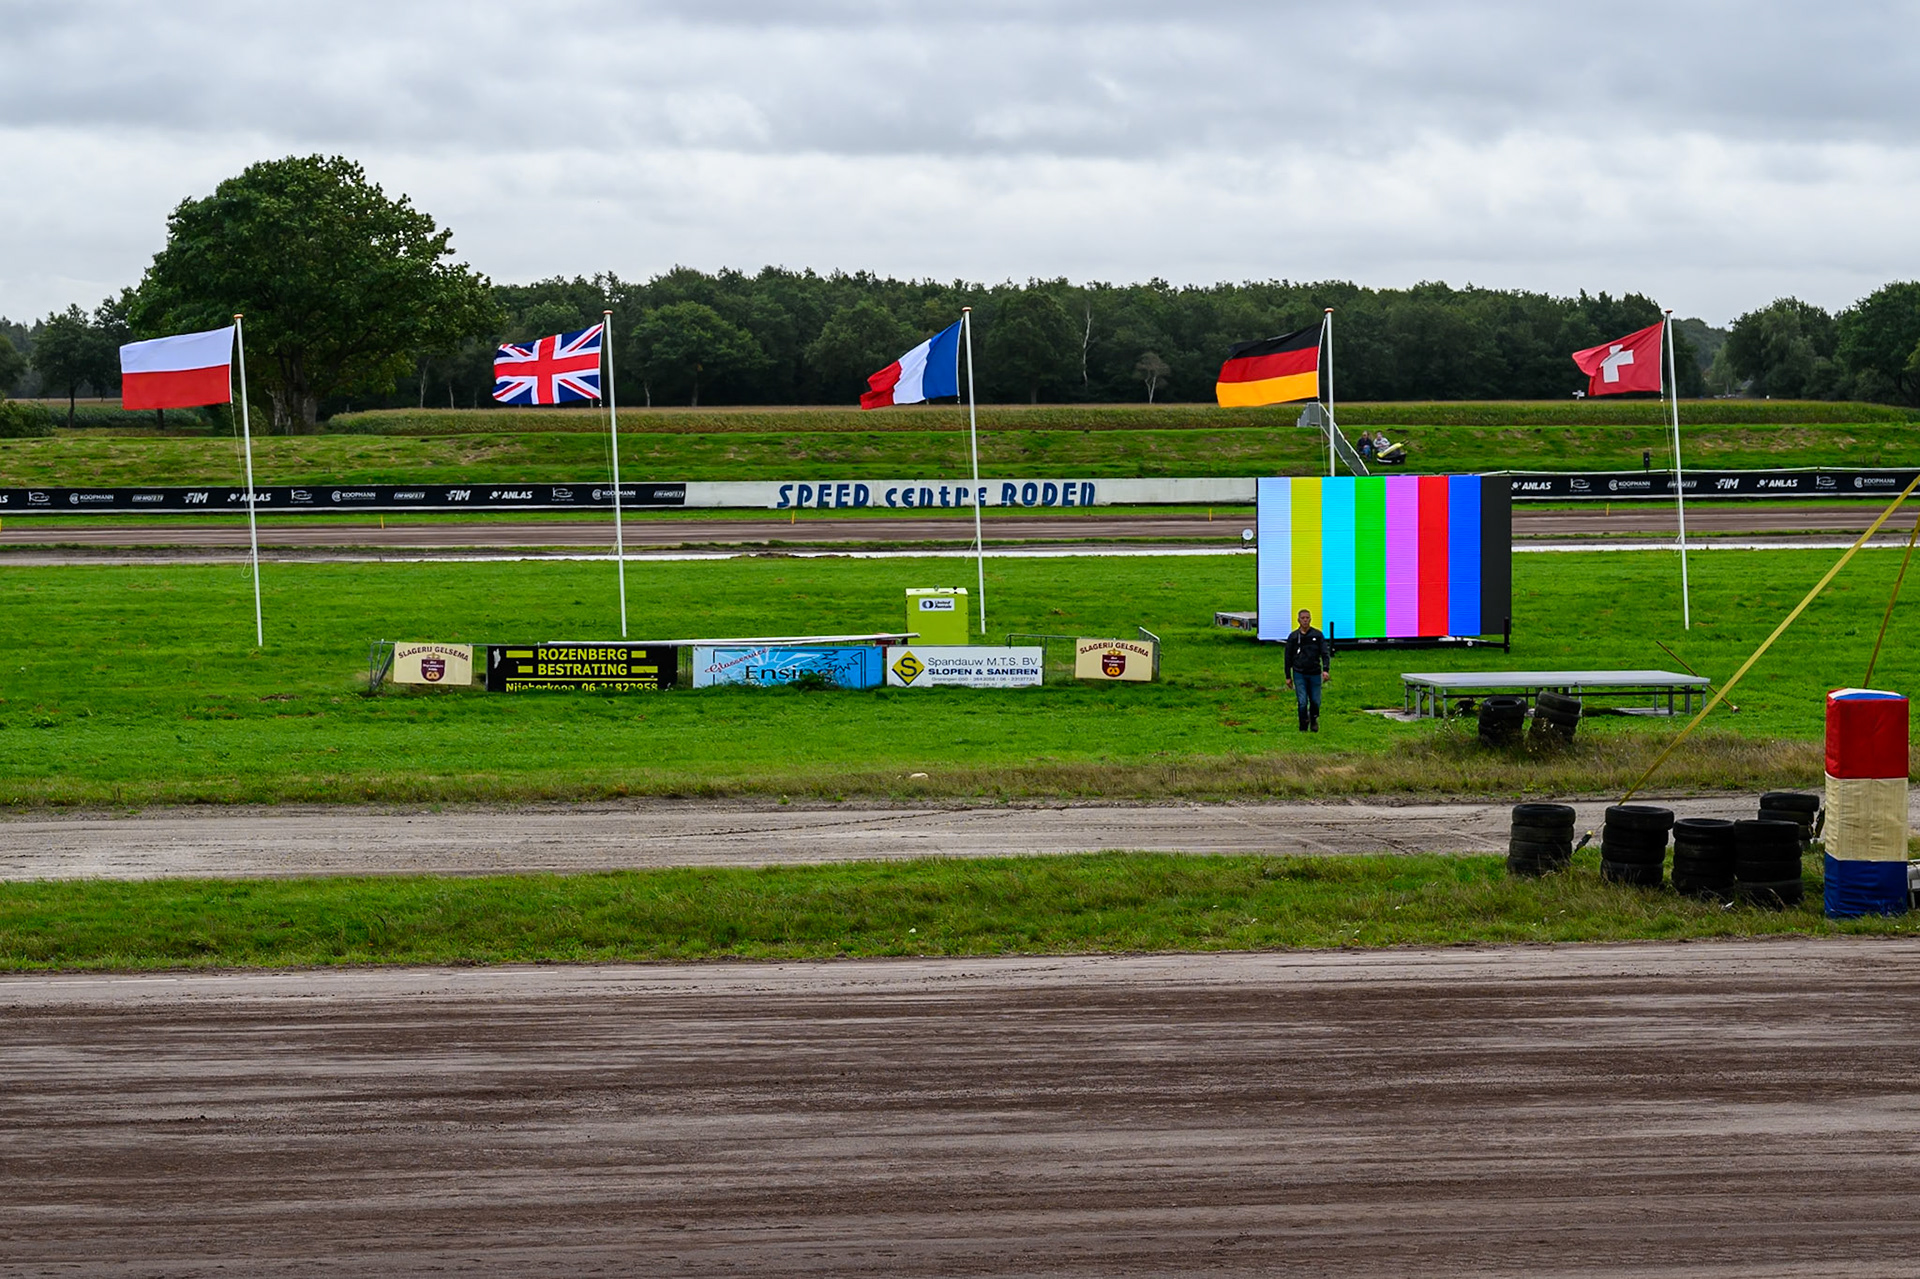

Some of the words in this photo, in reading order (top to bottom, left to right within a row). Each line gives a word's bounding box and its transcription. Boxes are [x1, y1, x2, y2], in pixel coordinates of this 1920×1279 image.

[1521, 481, 1552, 490] ANLAS
[1715, 478, 1739, 489] FIM
[1768, 479, 1798, 488] ANLAS
[183, 492, 208, 504] FIM
[446, 490, 471, 501] FIM
[501, 490, 533, 499] ANLAS
[776, 483, 870, 509] SPEED
[434, 646, 469, 661] GELSEMA
[538, 648, 628, 661] ROZENBERG
[1115, 642, 1149, 657] GELSEMA
[928, 657, 983, 667] Spandauw
[986, 657, 1019, 666] M.T.S.
[1022, 657, 1038, 666] BV
[538, 663, 628, 676] BESTRATING
[928, 668, 972, 676] SLOPEN
[975, 668, 984, 676] &
[986, 668, 1038, 676] SANEREN
